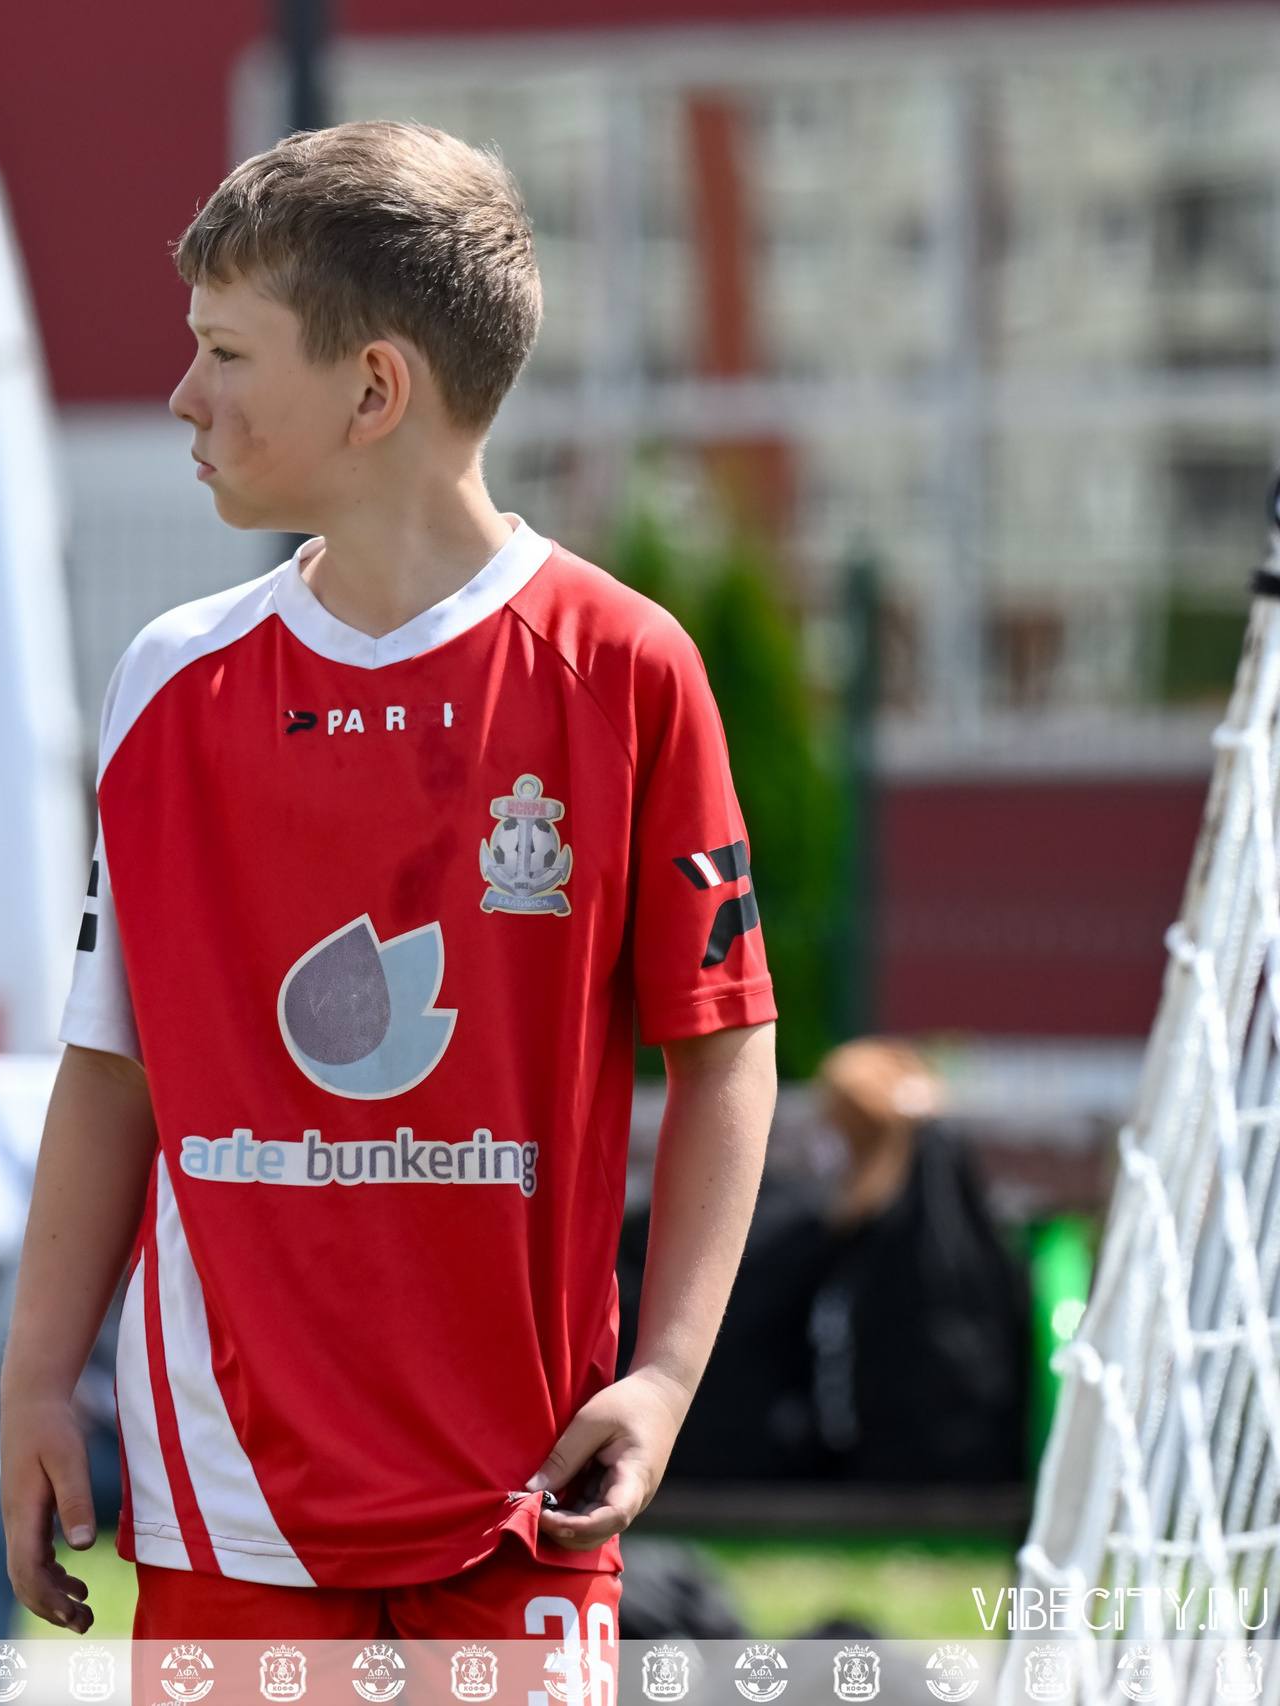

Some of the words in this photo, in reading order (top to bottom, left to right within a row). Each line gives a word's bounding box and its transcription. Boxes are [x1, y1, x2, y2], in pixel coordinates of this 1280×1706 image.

[497, 896, 549, 908] БАЛТИЙСК
[183, 1135, 285, 1180] arte
[307, 1132, 537, 1192] bunkering
[524, 1596, 616, 1706] 36
